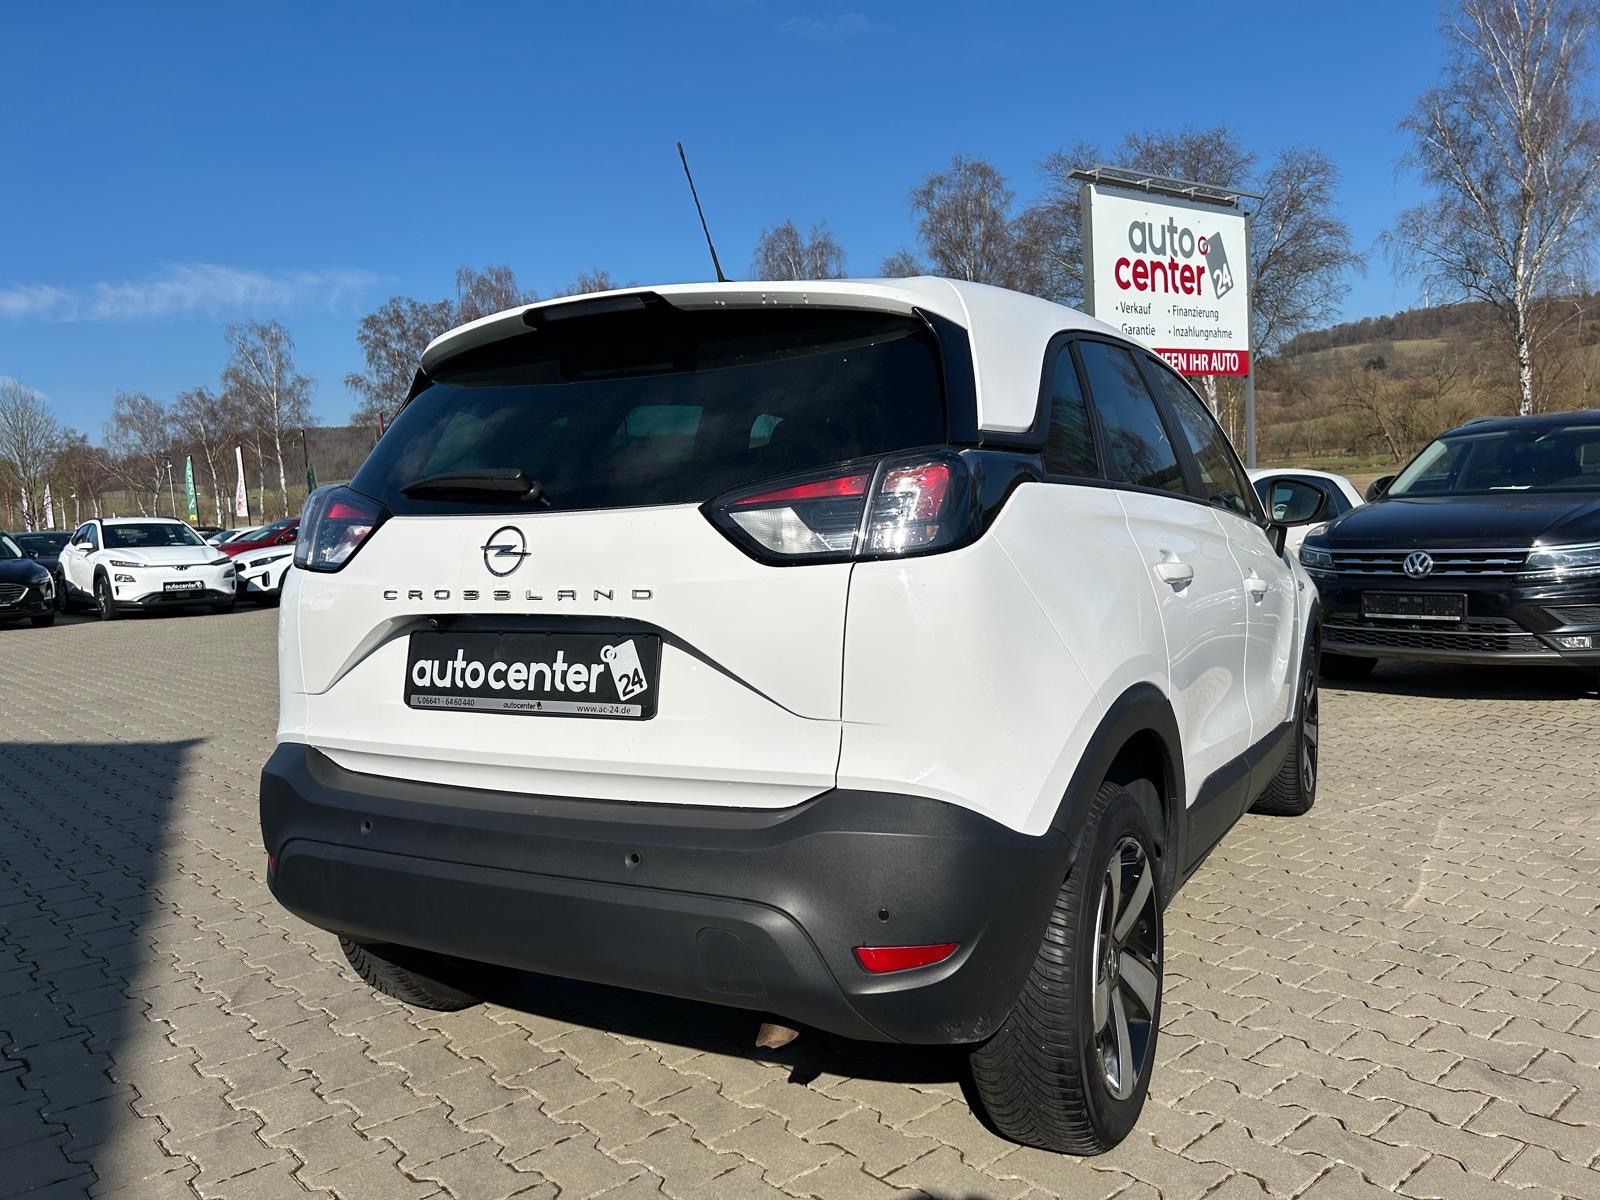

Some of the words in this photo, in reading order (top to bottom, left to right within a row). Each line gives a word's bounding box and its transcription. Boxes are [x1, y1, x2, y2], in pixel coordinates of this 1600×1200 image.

[1128, 217, 1195, 259] auto
[1115, 256, 1205, 295] center
[1213, 263, 1232, 293] 24
[1120, 302, 1151, 315] Verkauf
[1172, 305, 1219, 321] Finanzierung
[1173, 325, 1233, 340] Inzahlungnahme
[1189, 353, 1209, 371] IHR
[1211, 352, 1239, 371] AUTO
[383, 589, 654, 601] CROSSLAND
[411, 649, 605, 693] autocenter
[618, 667, 644, 698] 24
[503, 701, 536, 710] autocenter
[576, 705, 631, 714] www.ac-24.de
